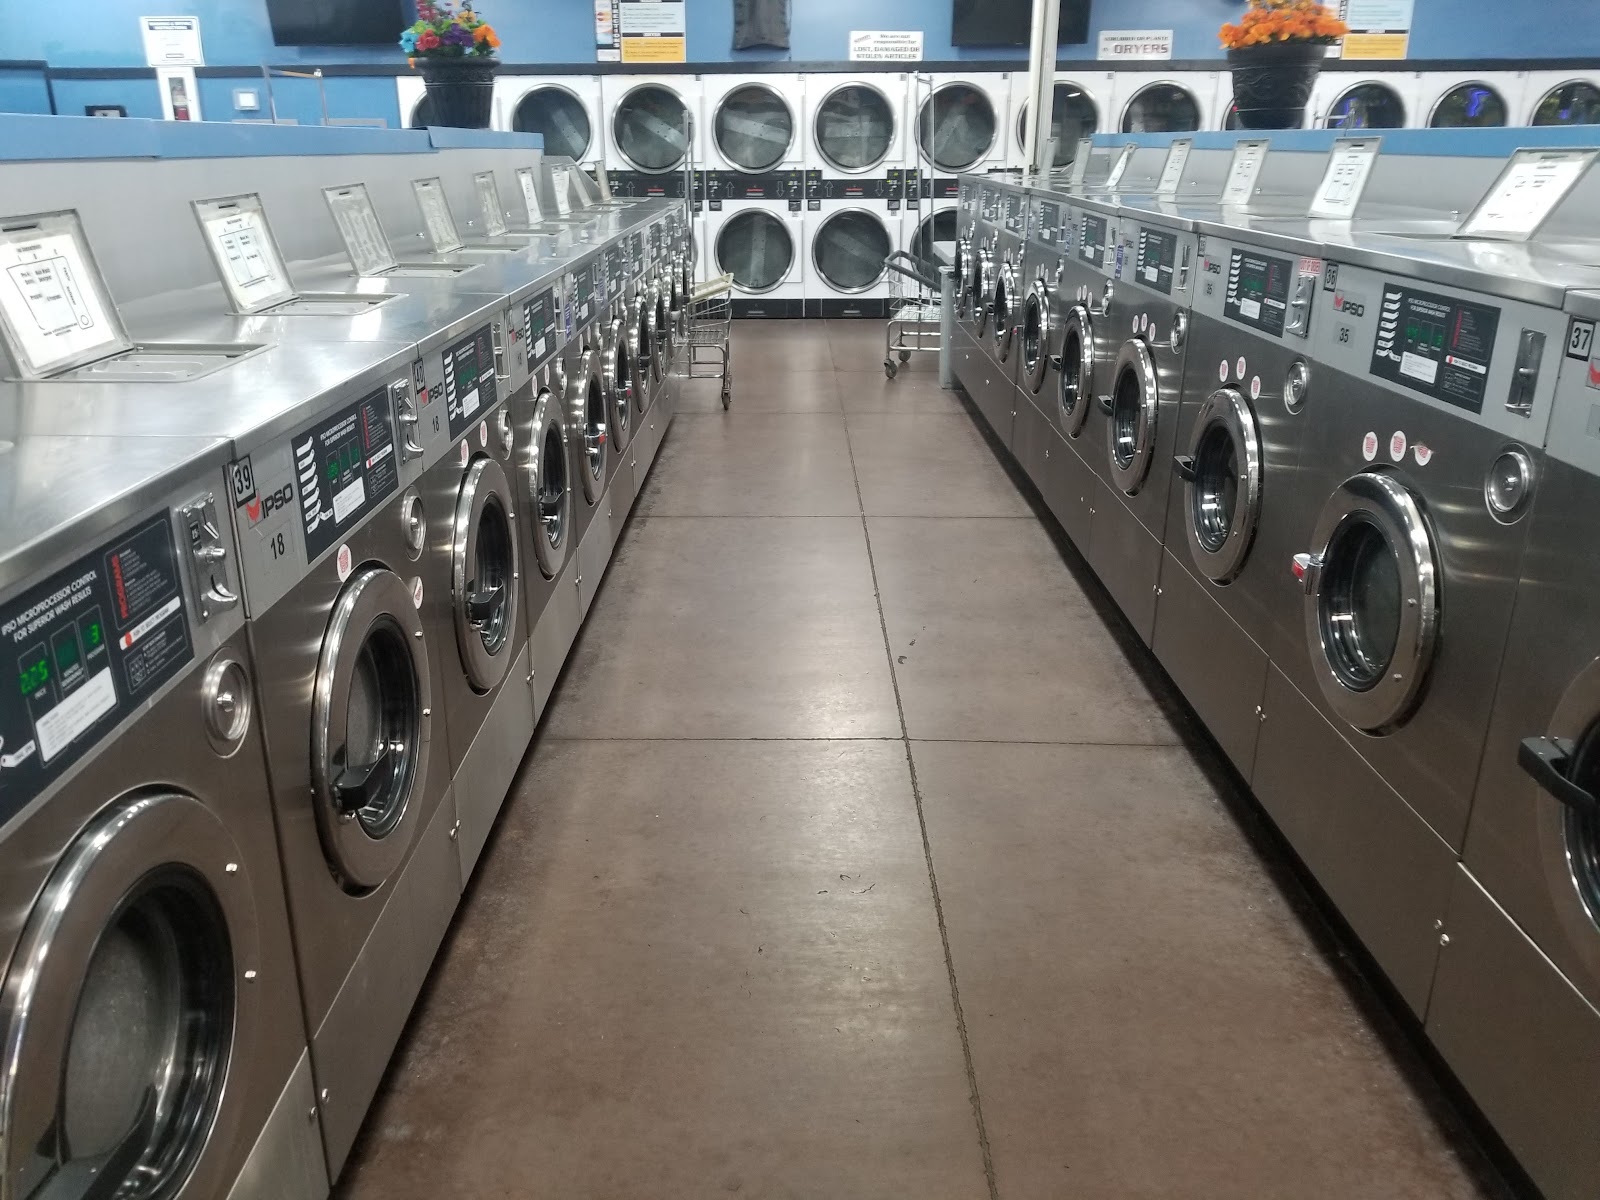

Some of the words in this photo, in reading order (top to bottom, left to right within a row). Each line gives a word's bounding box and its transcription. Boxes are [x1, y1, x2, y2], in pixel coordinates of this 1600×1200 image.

[1114, 43, 1169, 54] DRYERS
[1326, 269, 1336, 285] 36
[1340, 327, 1349, 343] 35
[1571, 327, 1591, 350] 37
[432, 415, 440, 434] 18
[235, 465, 251, 494] 39
[261, 483, 293, 519] IPSO
[270, 533, 285, 559] 18
[1, 621, 17, 636] IPSO
[16, 585, 71, 626] MICROPROCESSOR
[71, 570, 97, 591] CONTROL
[13, 628, 28, 643] FOR
[27, 609, 55, 635] SUPERIOR
[55, 599, 72, 616] WASH
[71, 585, 92, 605] RESULTS
[90, 624, 99, 644] 3
